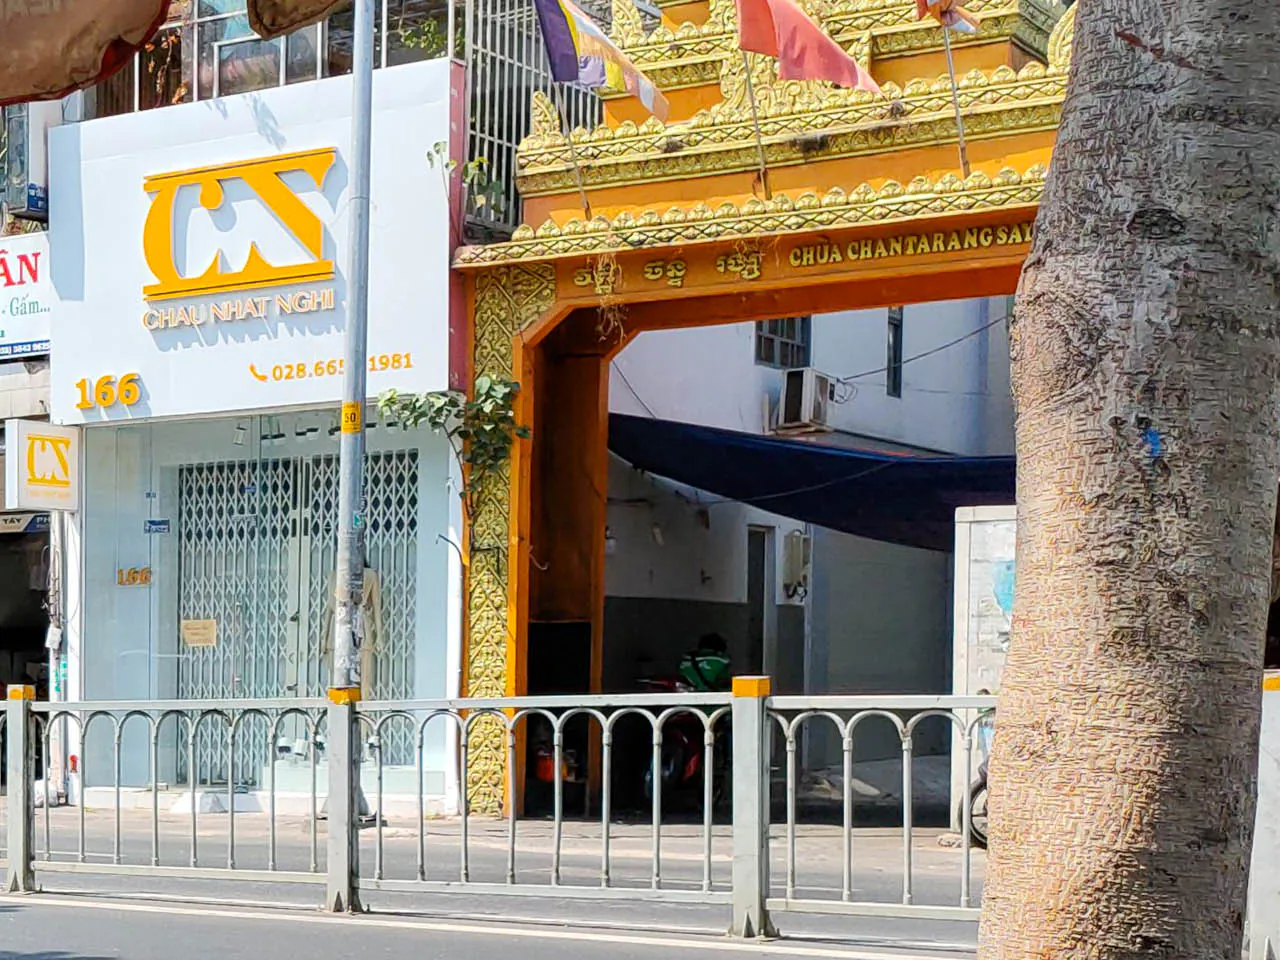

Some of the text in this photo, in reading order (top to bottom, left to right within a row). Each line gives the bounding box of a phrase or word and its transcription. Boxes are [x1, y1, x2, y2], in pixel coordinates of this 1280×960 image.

[788, 234, 842, 267] CHÙA
[275, 288, 335, 314] NGHI
[368, 352, 414, 372] 1981
[75, 372, 140, 409] 166
[116, 565, 152, 587] 166
